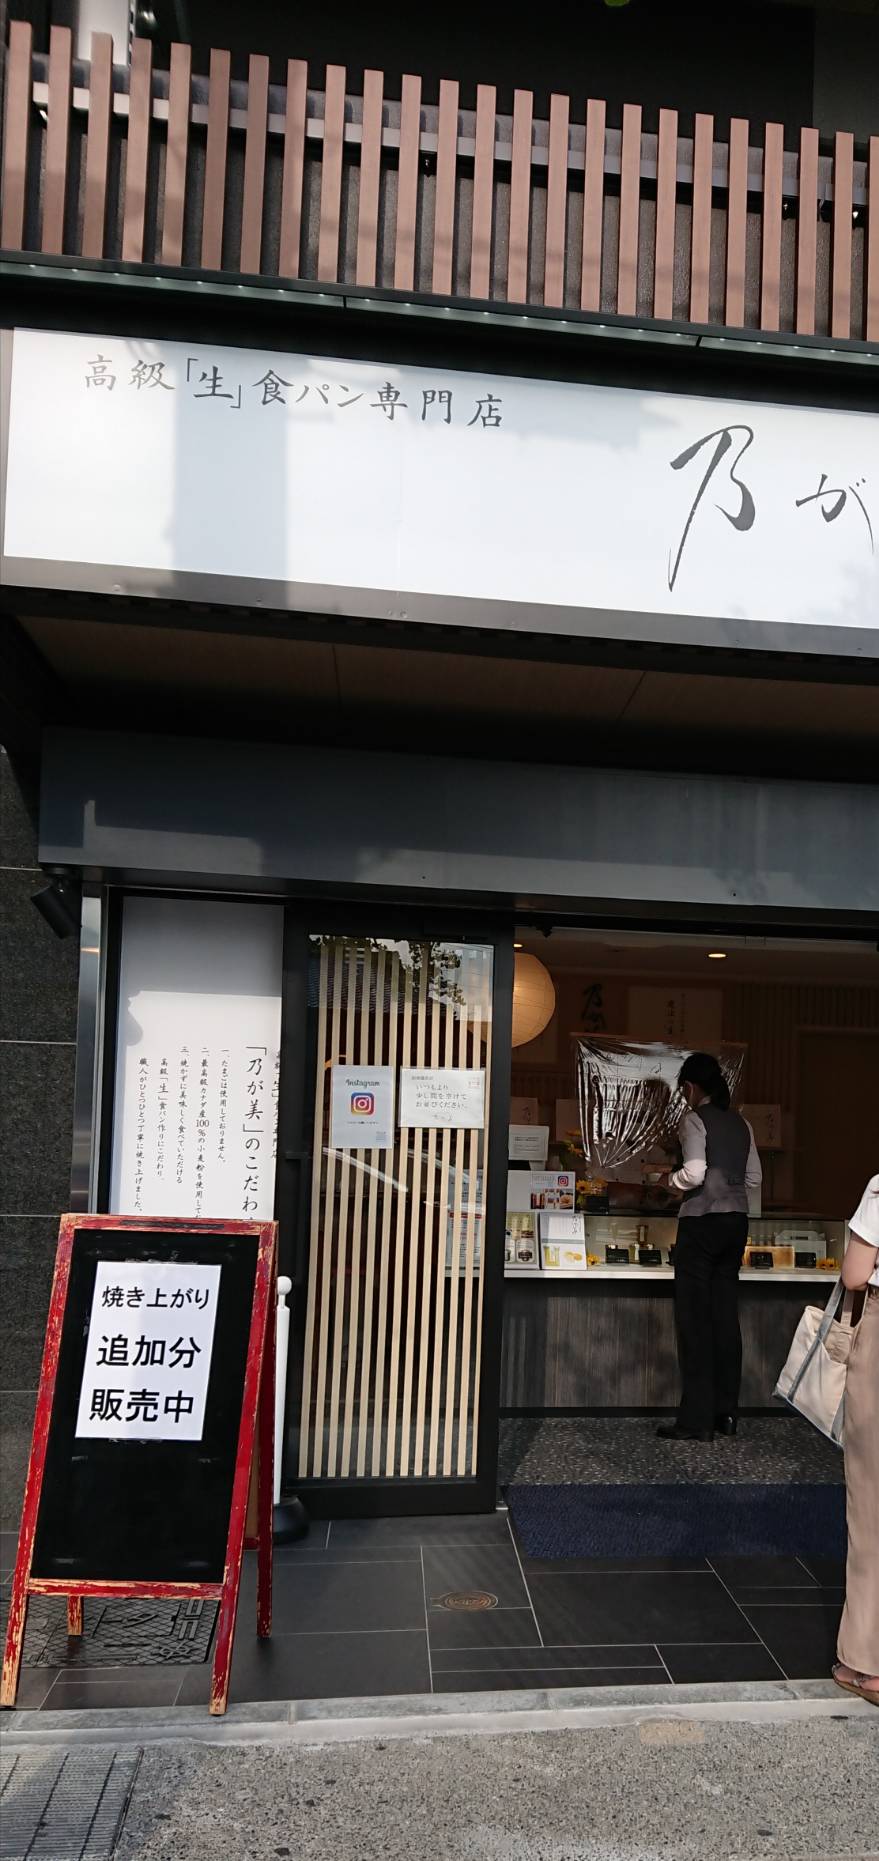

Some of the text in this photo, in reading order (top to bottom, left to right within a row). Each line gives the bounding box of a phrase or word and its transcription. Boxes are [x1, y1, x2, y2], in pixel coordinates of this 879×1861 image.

[84, 354, 503, 428] 高級「生」食パン専門店
[668, 425, 874, 592] 乃が
[345, 1078, 381, 1090] Instagram
[242, 1046, 267, 1220] 「乃が美」のこだわ
[102, 1285, 210, 1309] 焼き上がり
[96, 1334, 202, 1368] 追加分
[89, 1388, 194, 1423] 販売中
